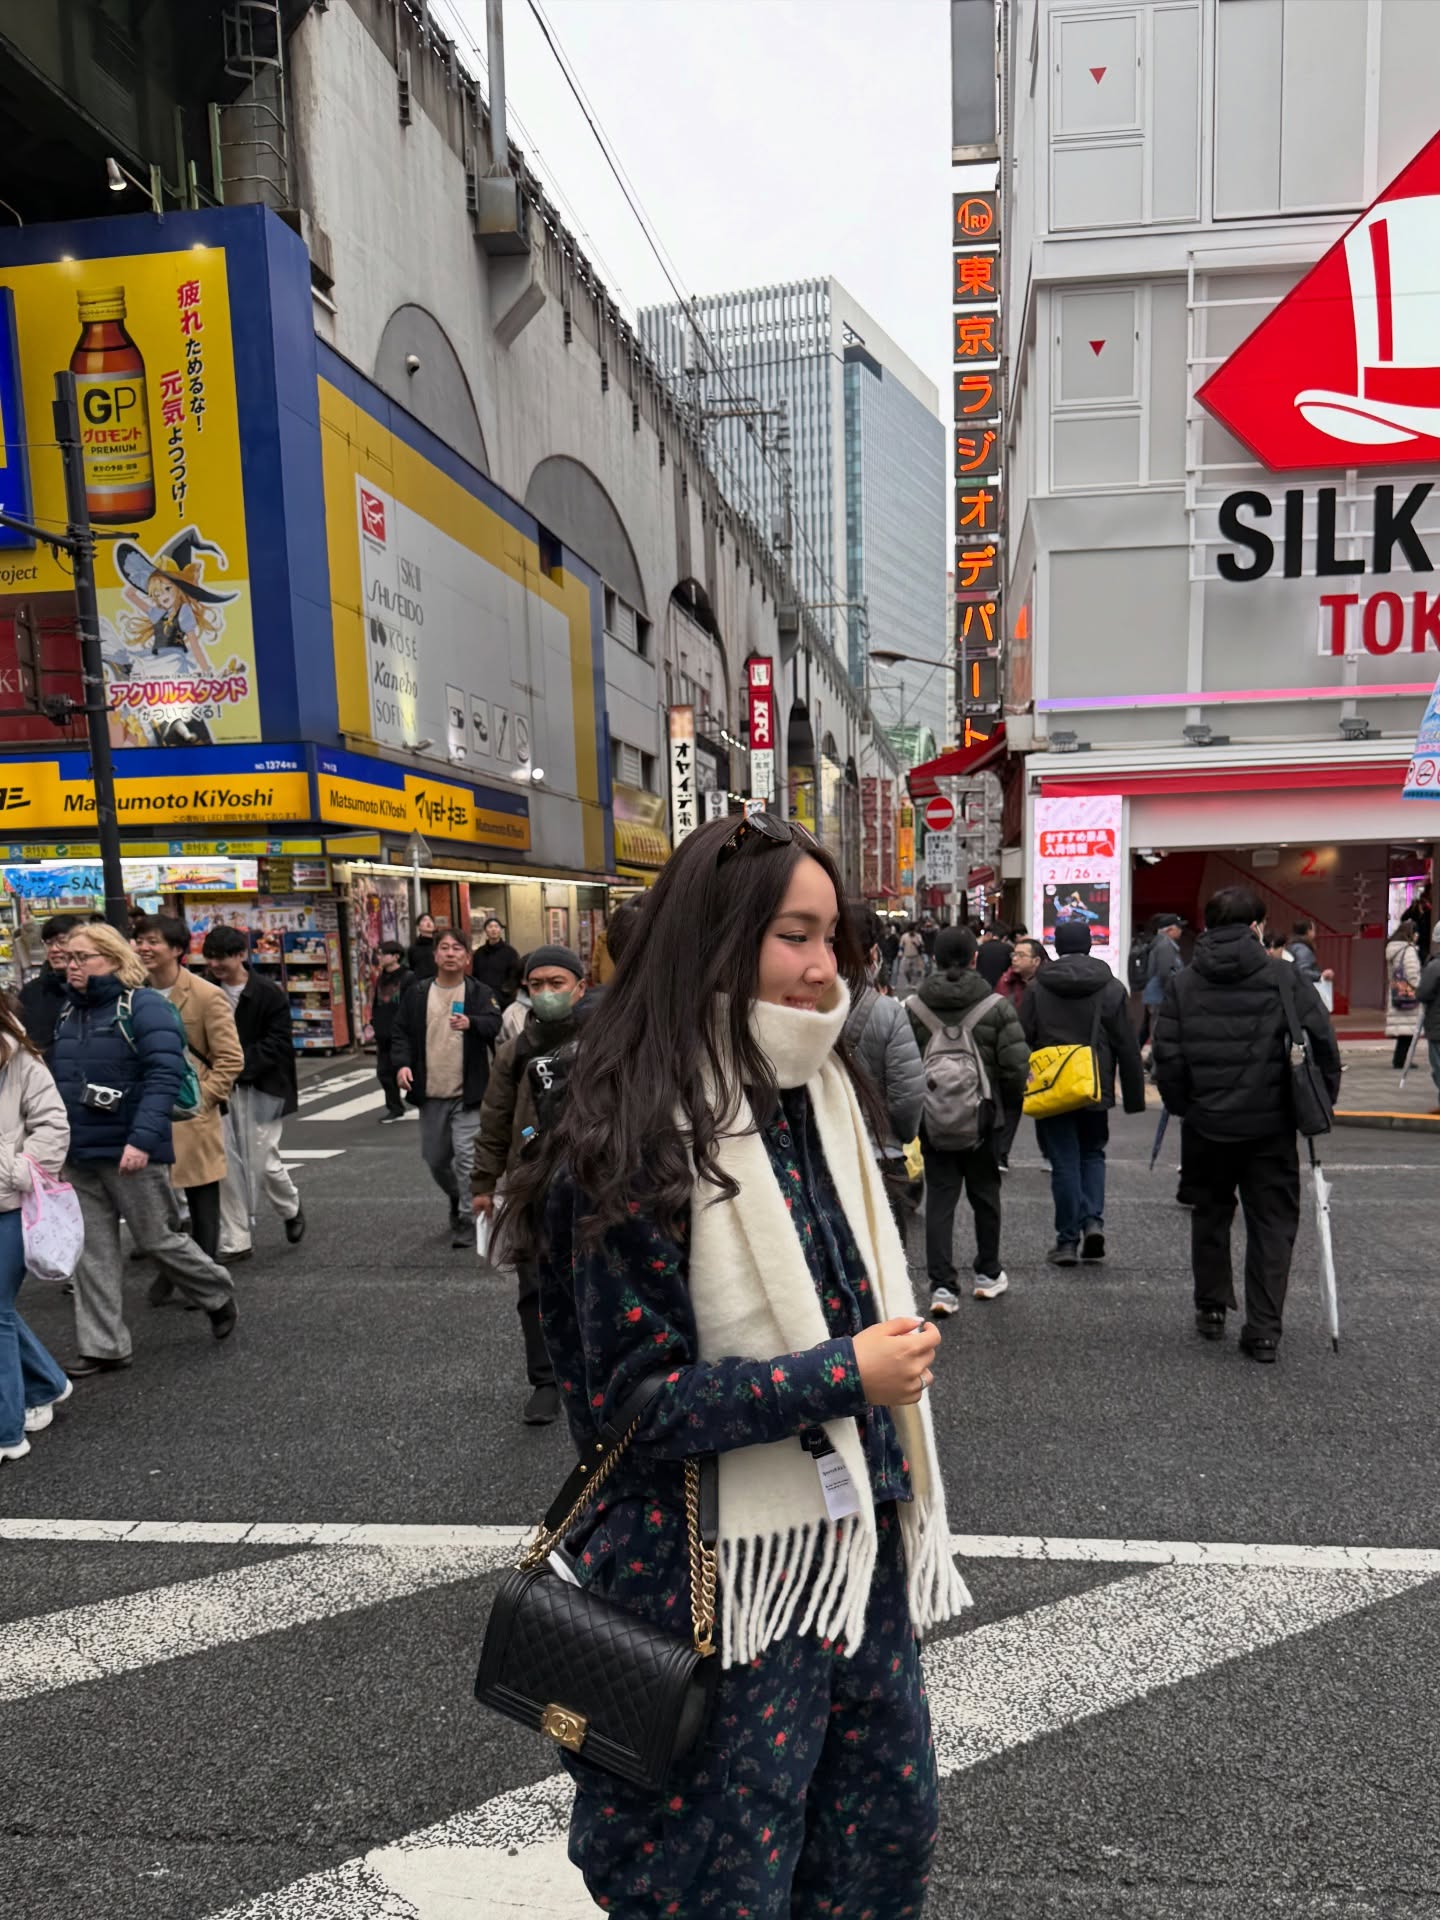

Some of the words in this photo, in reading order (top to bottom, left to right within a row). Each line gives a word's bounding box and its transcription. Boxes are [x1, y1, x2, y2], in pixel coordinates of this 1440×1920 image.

[83, 387, 137, 424] GP
[83, 427, 142, 443] グロモント
[91, 444, 137, 454] PREMIUM
[956, 255, 997, 748] 東京ラジオデパート
[1217, 483, 1435, 582] SILK
[0, 565, 38, 586] oject
[368, 579, 424, 626] SHISEIDO
[1319, 591, 1440, 656] TOK
[110, 677, 248, 708] アクリルスタンド
[374, 661, 418, 698] Kanebo
[753, 699, 769, 743] KFC
[64, 792, 188, 812] Maumoto
[192, 788, 273, 807] KiYoshi
[329, 789, 379, 815] Matsumoto
[379, 799, 407, 819] KiYoshi
